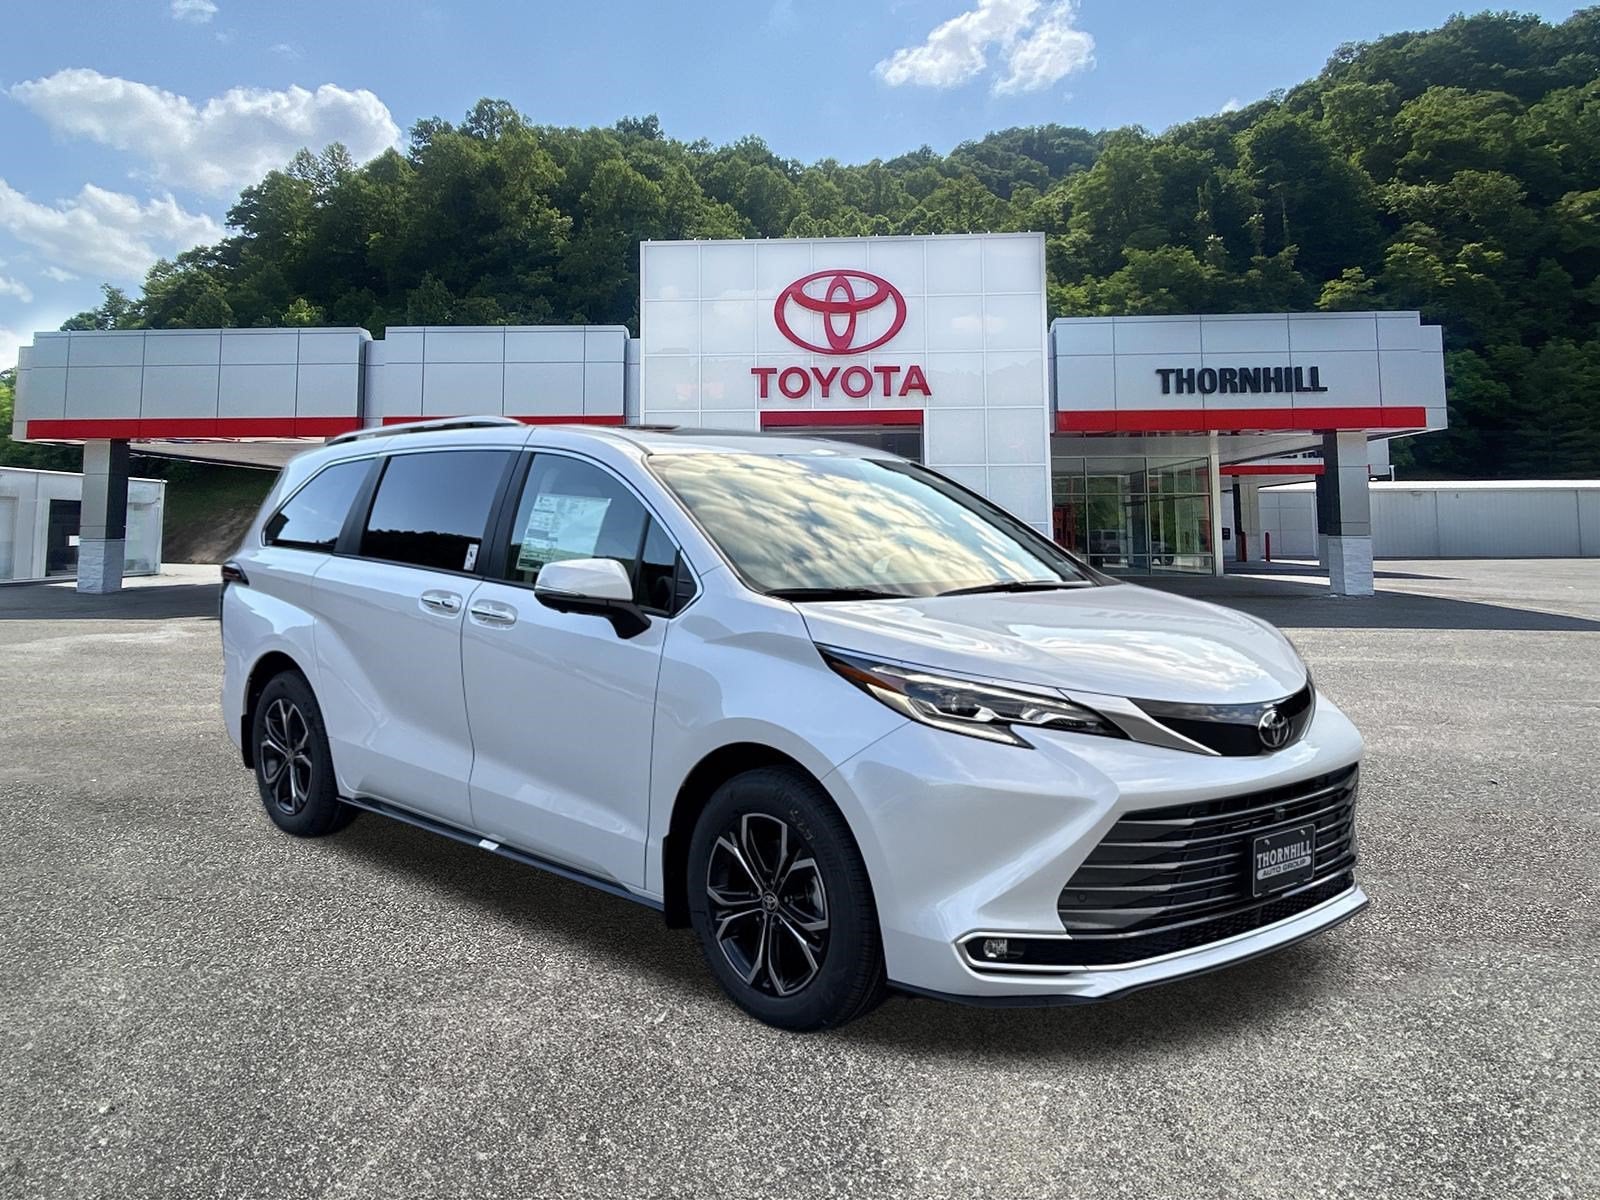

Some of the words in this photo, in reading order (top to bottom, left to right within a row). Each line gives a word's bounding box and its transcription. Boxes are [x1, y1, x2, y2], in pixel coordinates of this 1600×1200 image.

[751, 365, 932, 399] TOYOTA
[1156, 366, 1328, 394] THORNHILL
[1256, 840, 1312, 869] THORNHILL
[1263, 864, 1281, 876] AUTO
